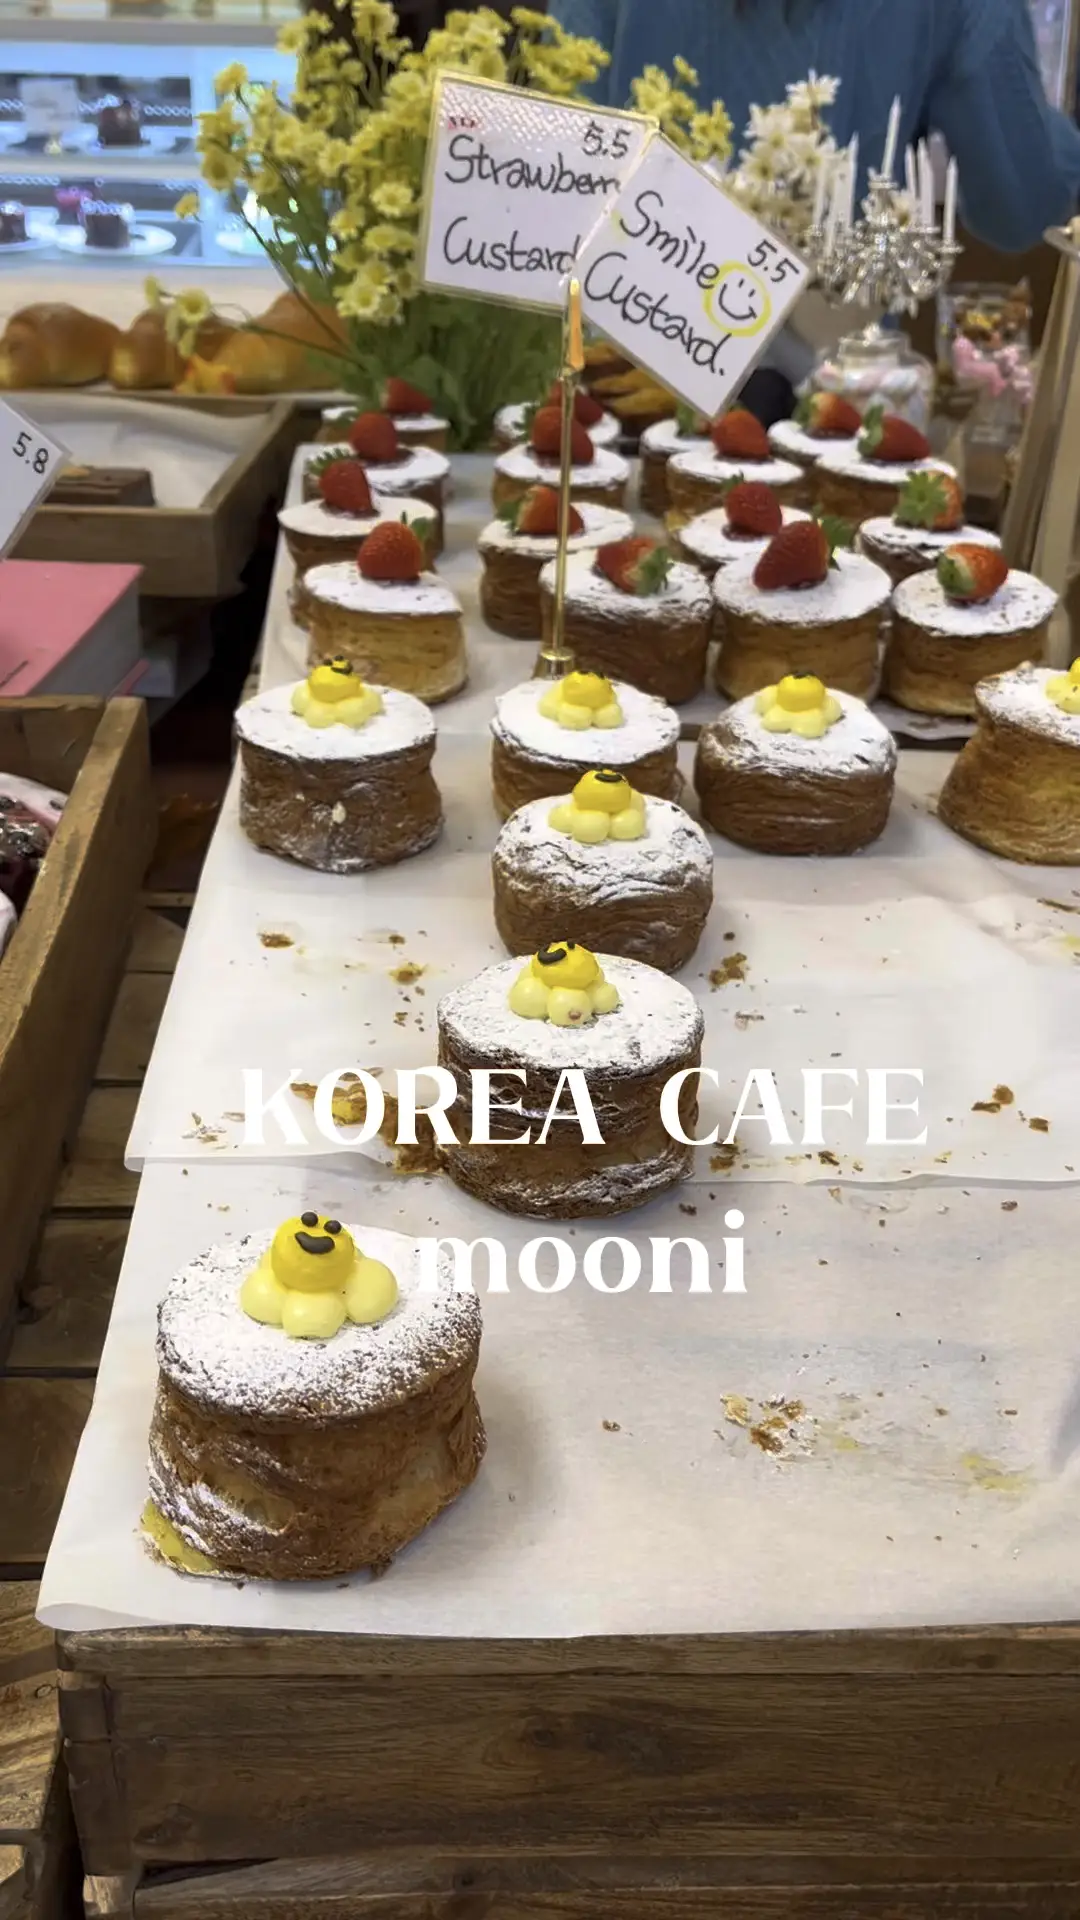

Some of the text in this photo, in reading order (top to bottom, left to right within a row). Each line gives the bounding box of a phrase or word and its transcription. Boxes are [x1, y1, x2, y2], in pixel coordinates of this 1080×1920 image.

[445, 134, 620, 195] Strawberr
[582, 121, 631, 160] 5.5
[443, 216, 581, 274] Custard
[619, 190, 720, 290] Smile
[747, 239, 799, 284] 5.5
[583, 251, 732, 377] Custard.
[12, 431, 49, 474] 5.8
